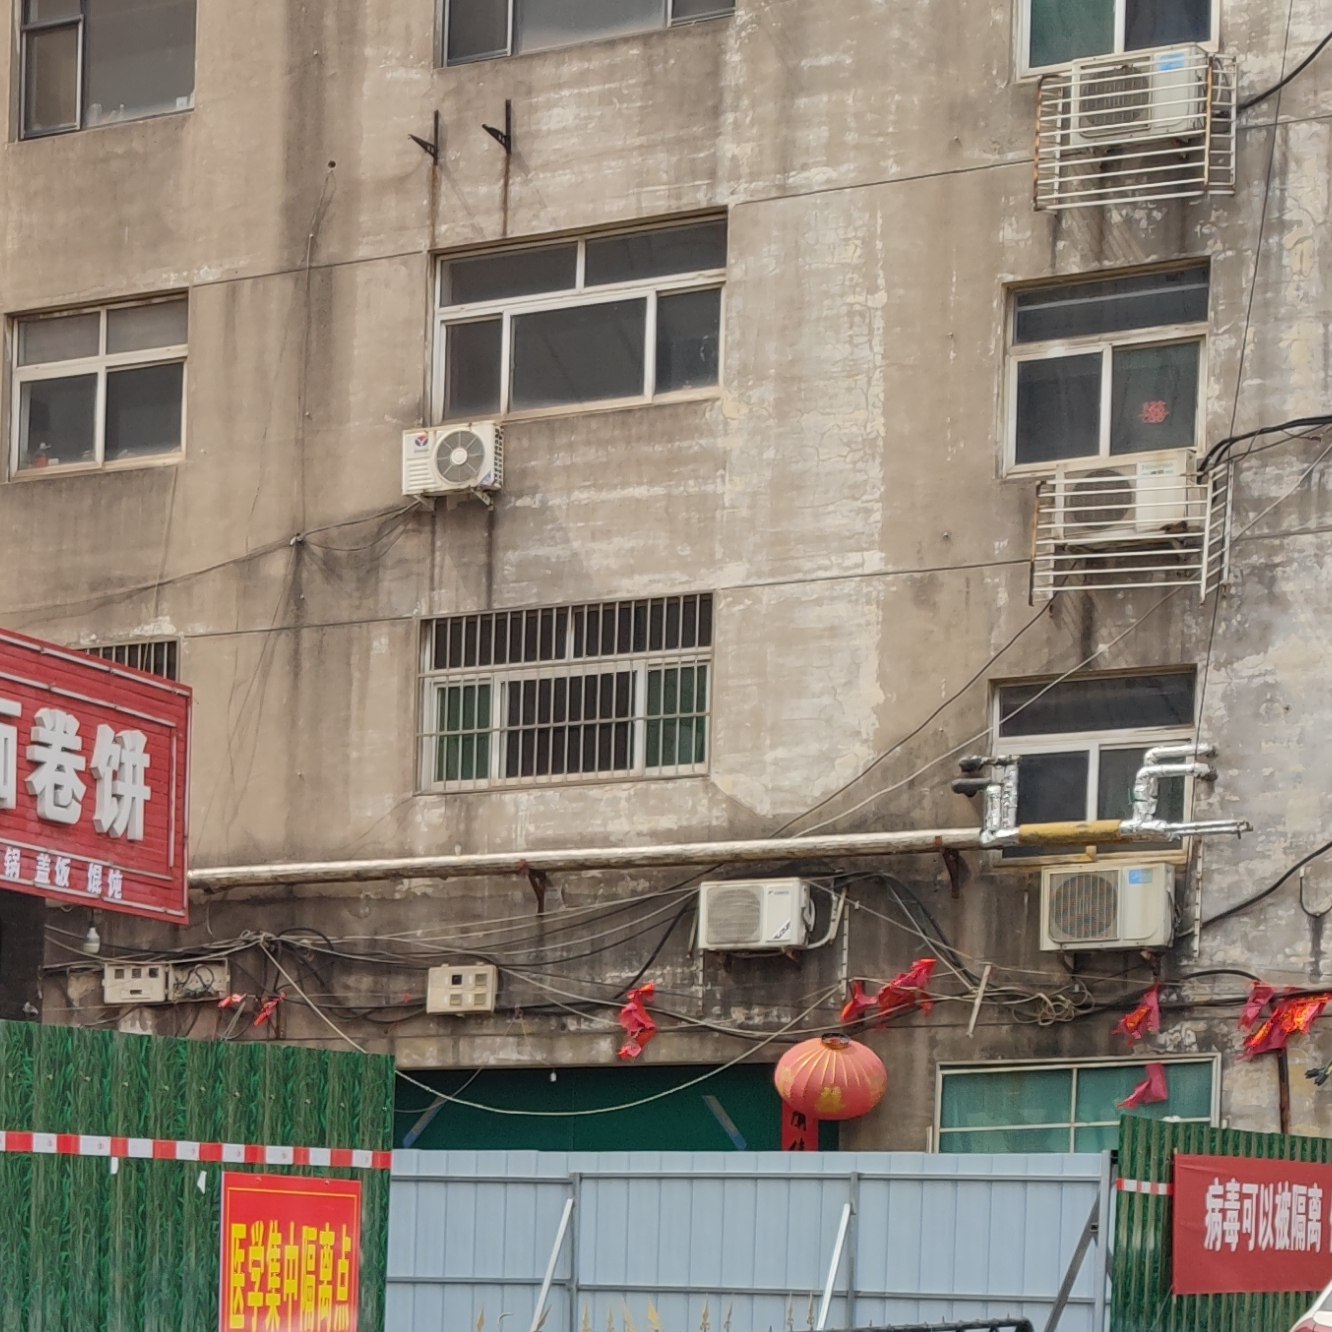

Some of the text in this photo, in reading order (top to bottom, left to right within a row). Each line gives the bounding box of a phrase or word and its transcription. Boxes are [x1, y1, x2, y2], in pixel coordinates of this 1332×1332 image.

[35, 853, 71, 888] 盖饭
[87, 863, 123, 899] 馄饨
[1203, 1176, 1323, 1253] 病毒可以被隔离
